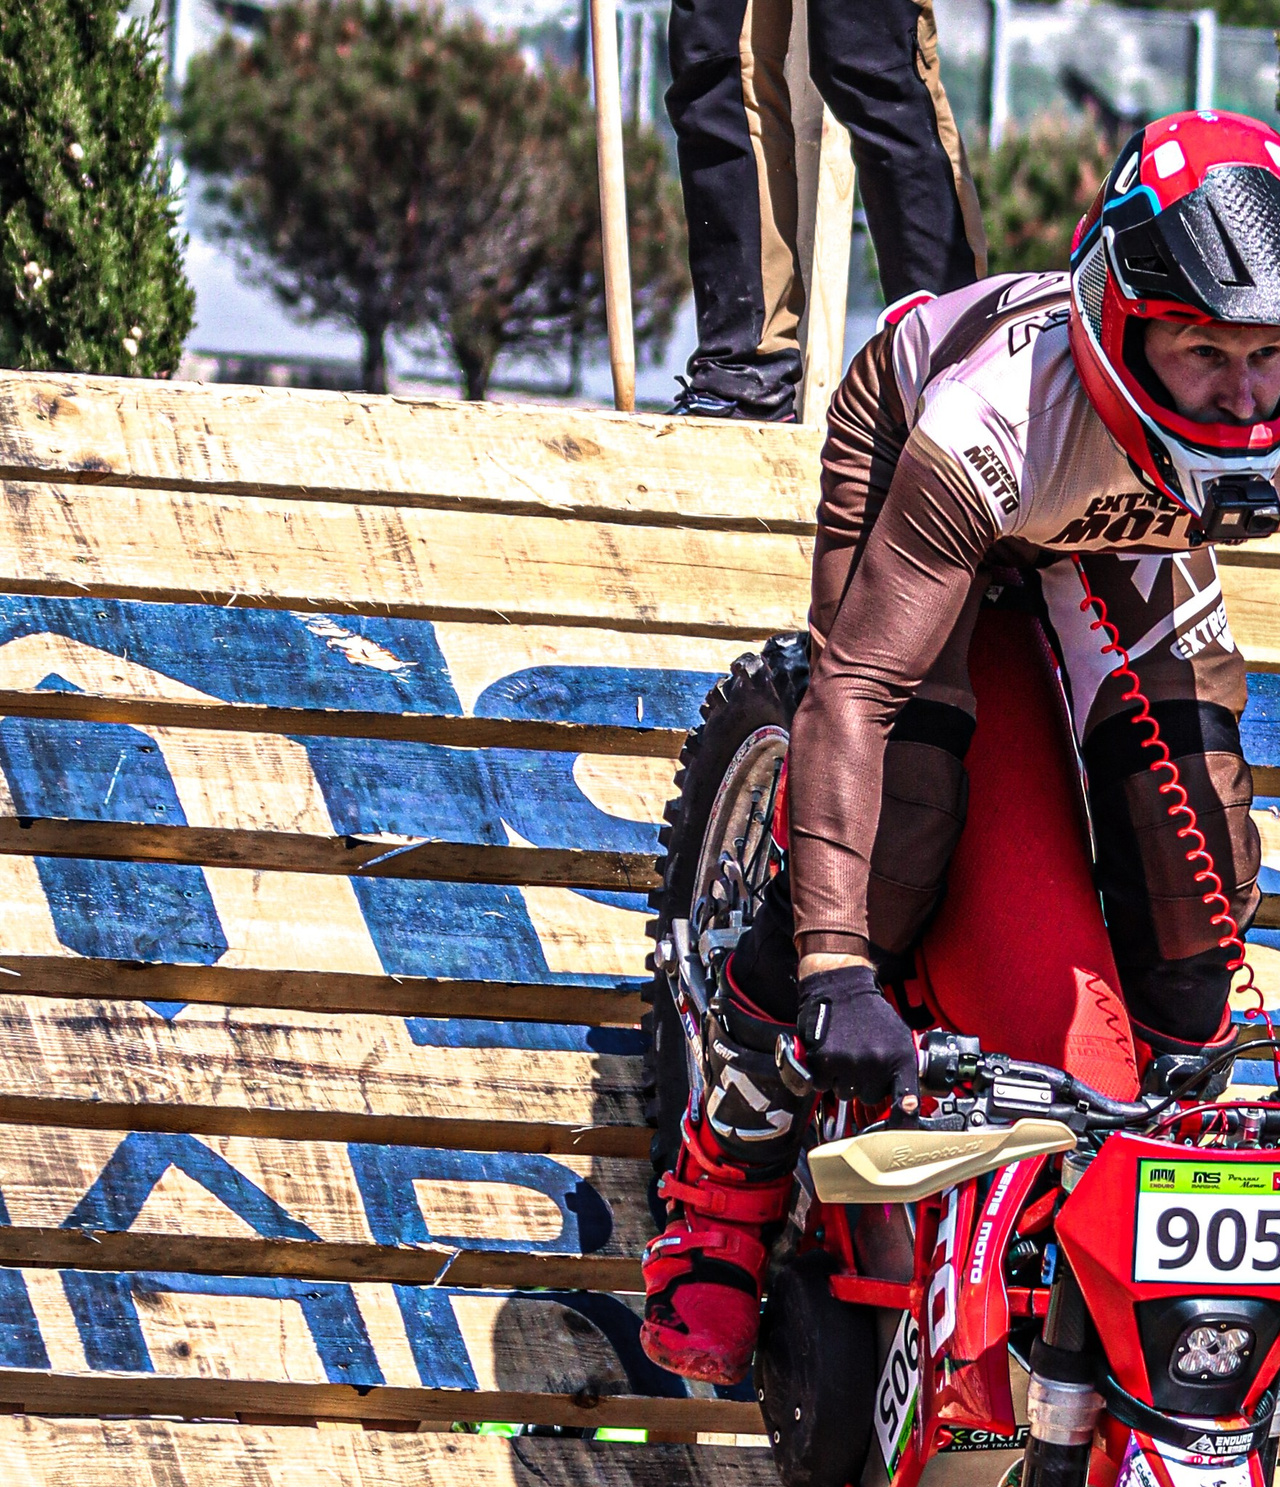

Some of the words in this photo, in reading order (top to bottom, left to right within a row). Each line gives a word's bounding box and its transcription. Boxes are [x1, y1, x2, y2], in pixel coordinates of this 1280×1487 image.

[963, 445, 1019, 515] MOTO
[1084, 493, 1188, 517] EXTRE
[1042, 509, 1201, 544] MOT
[1170, 603, 1228, 660] EXTRE
[986, 1160, 1020, 1216] REME
[970, 1222, 993, 1284] MOTO
[879, 1311, 919, 1444] 905
[1215, 1432, 1254, 1447] ENDURO
